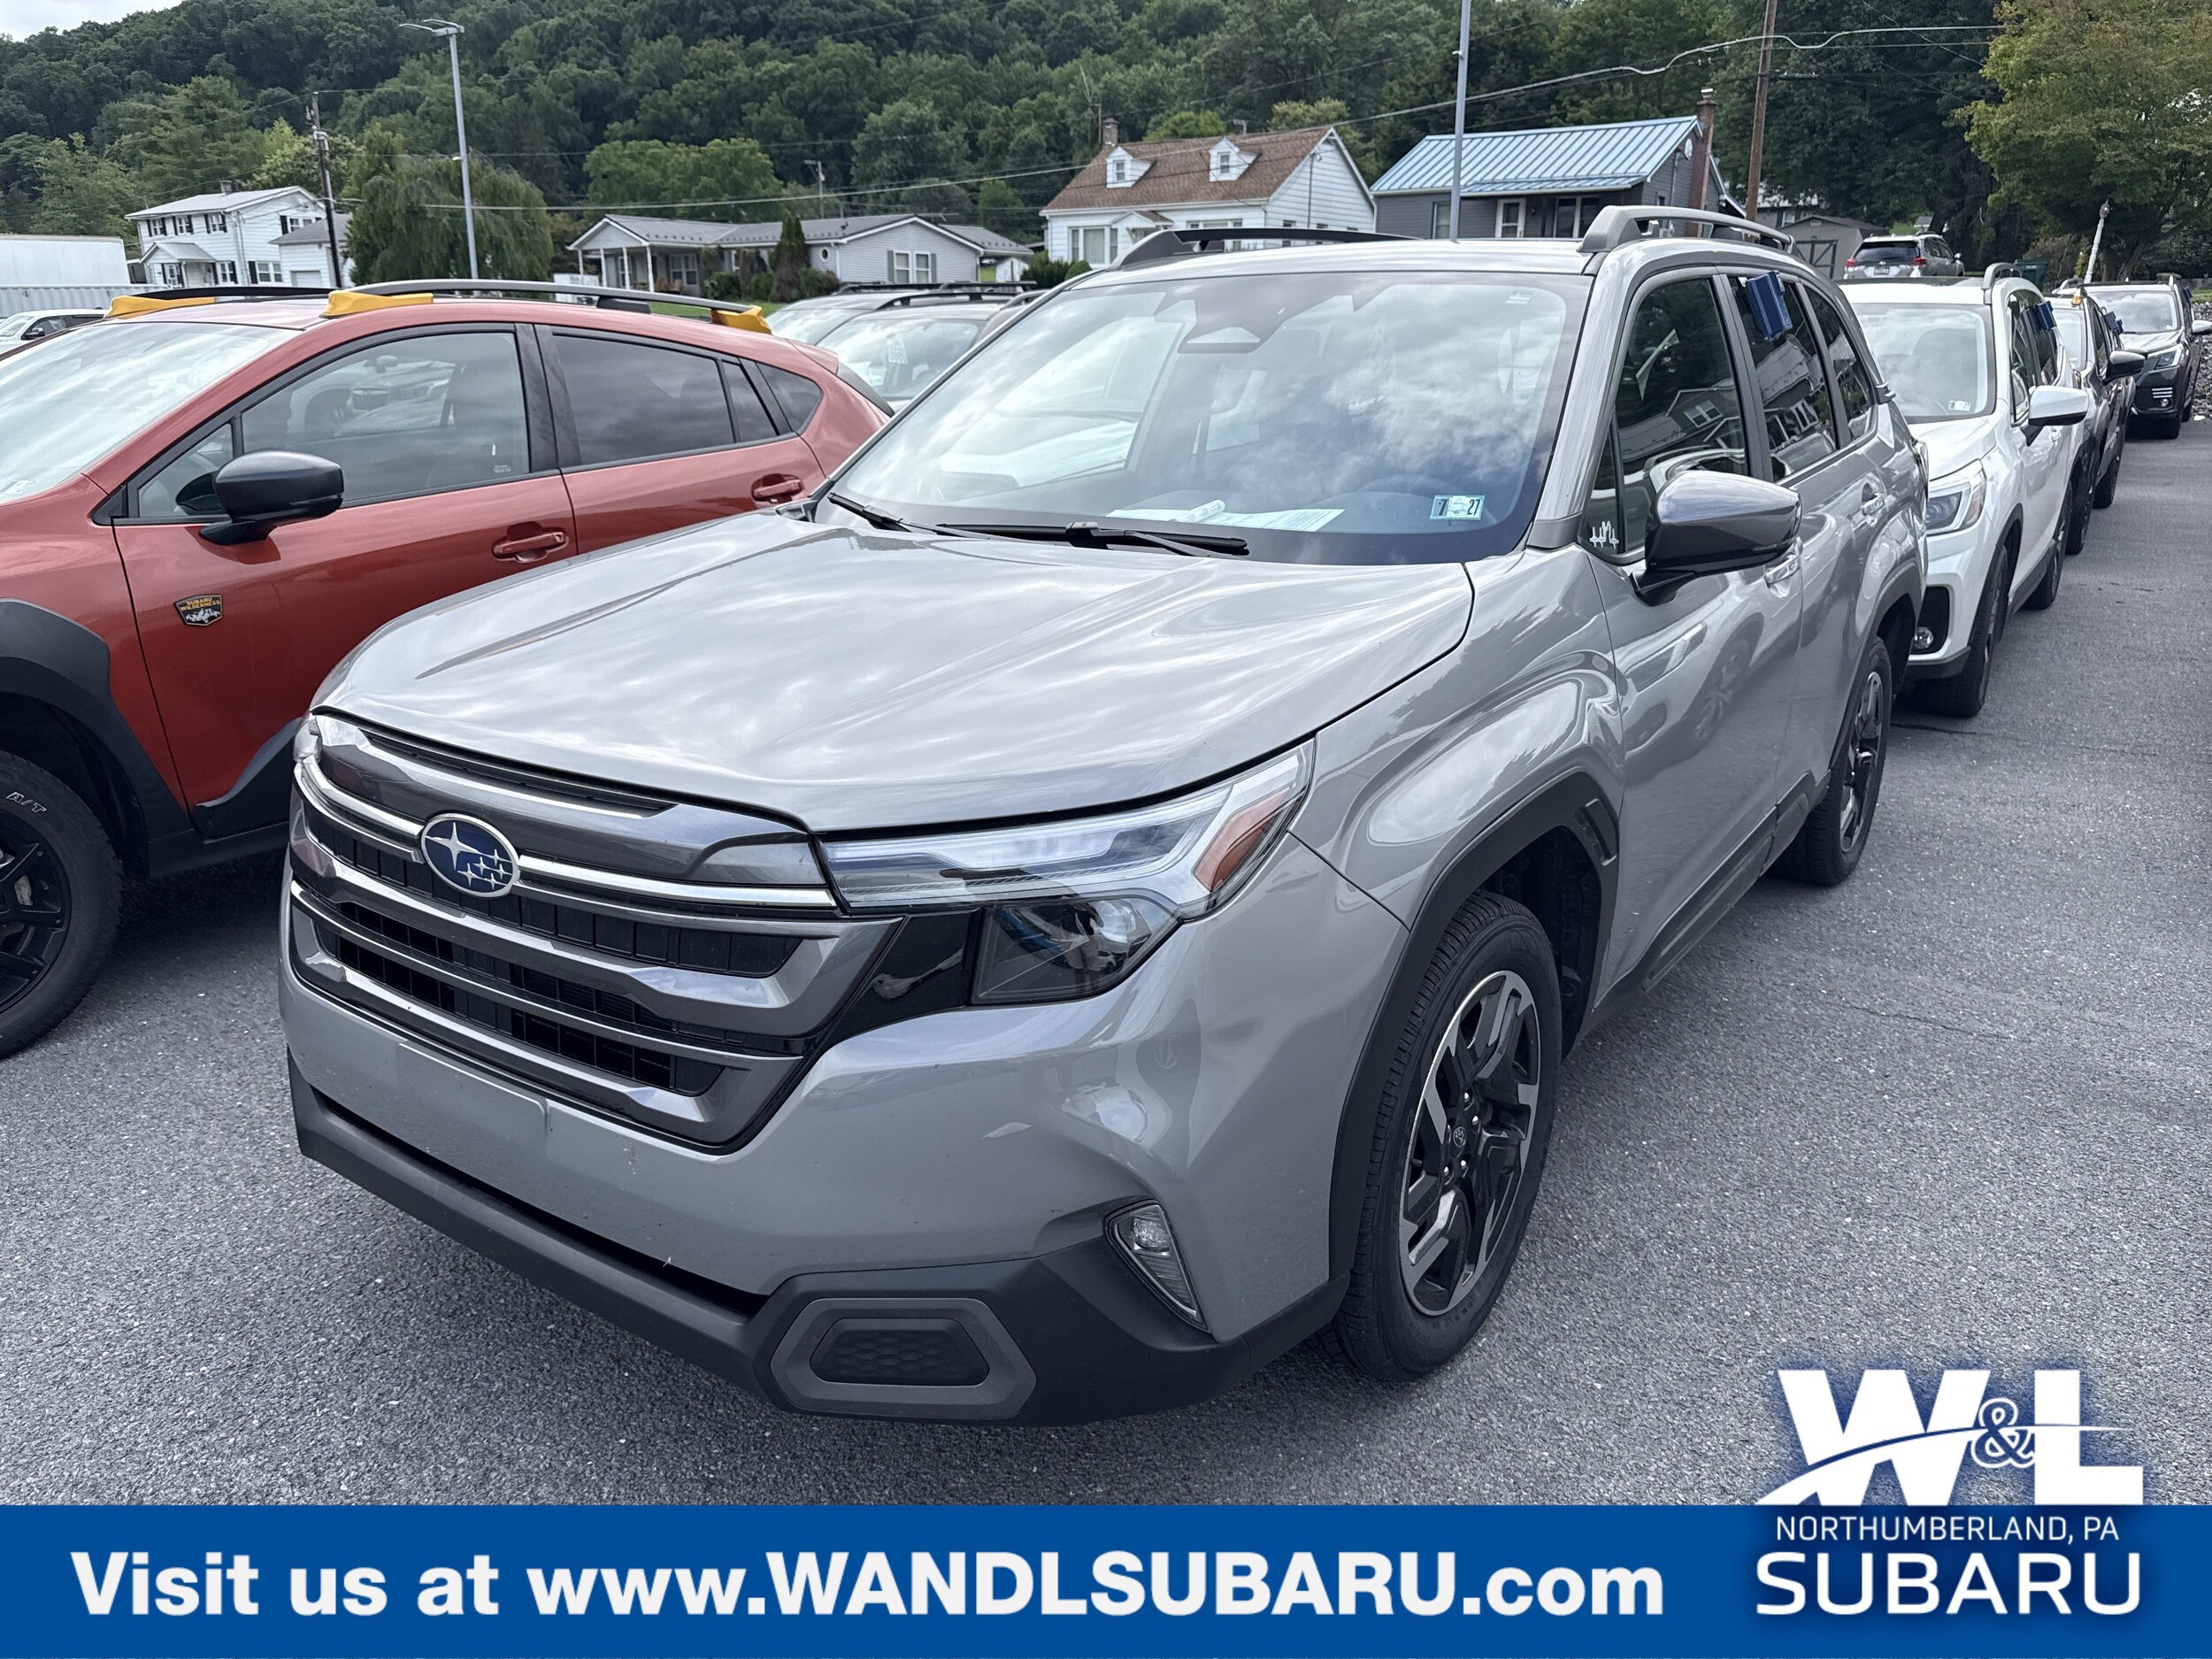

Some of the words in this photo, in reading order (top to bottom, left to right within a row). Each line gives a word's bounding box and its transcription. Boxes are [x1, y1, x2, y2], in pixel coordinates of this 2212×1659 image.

[1439, 499, 1448, 516] 7
[1467, 499, 1480, 515] 27
[180, 600, 221, 611] WILDERNESS
[7, 792, 47, 812] A/T
